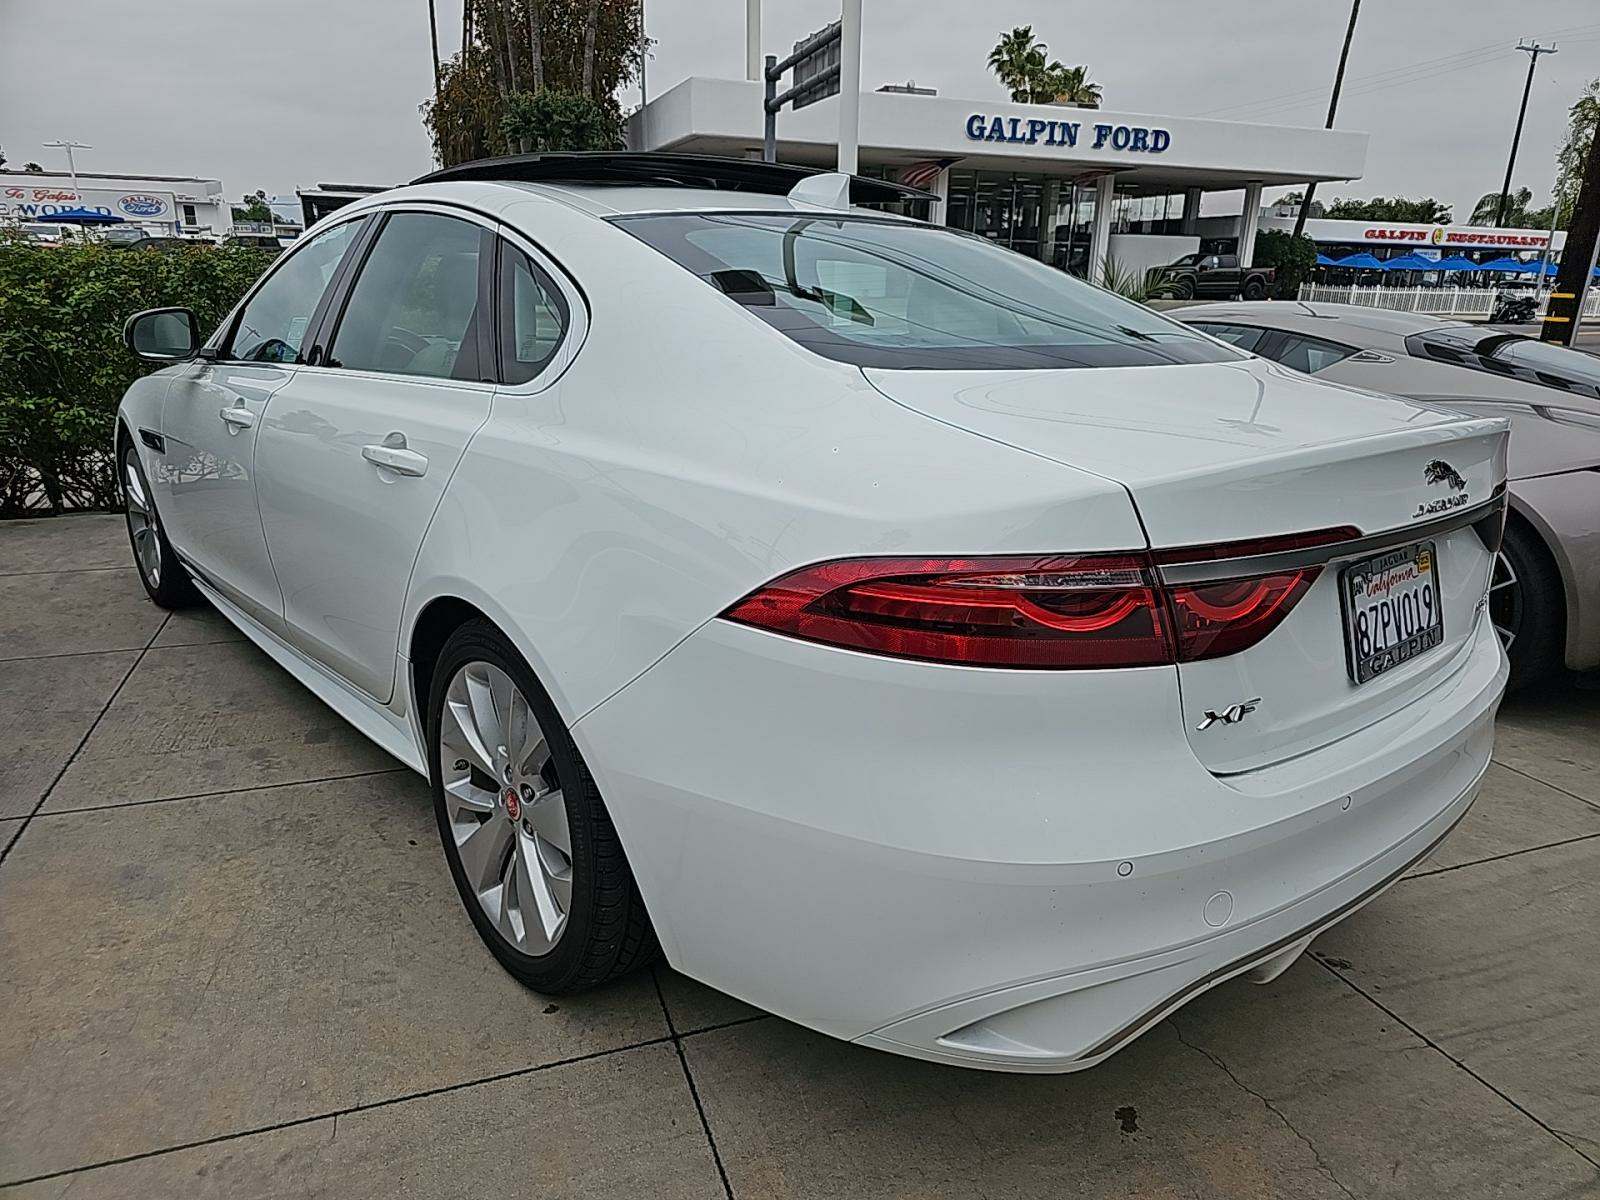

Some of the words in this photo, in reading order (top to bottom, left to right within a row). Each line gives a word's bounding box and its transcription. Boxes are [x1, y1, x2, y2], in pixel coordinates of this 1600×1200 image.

[966, 114, 1081, 147] GALPIN
[1092, 124, 1171, 153] FORD
[1364, 229, 1428, 241] GALPIN
[1446, 233, 1549, 247] RESTAURANT
[1379, 551, 1409, 570] JAGUAR
[1357, 583, 1432, 660] 8ZPV019
[1370, 628, 1438, 673] GALPIN
[1196, 697, 1261, 731] XF
